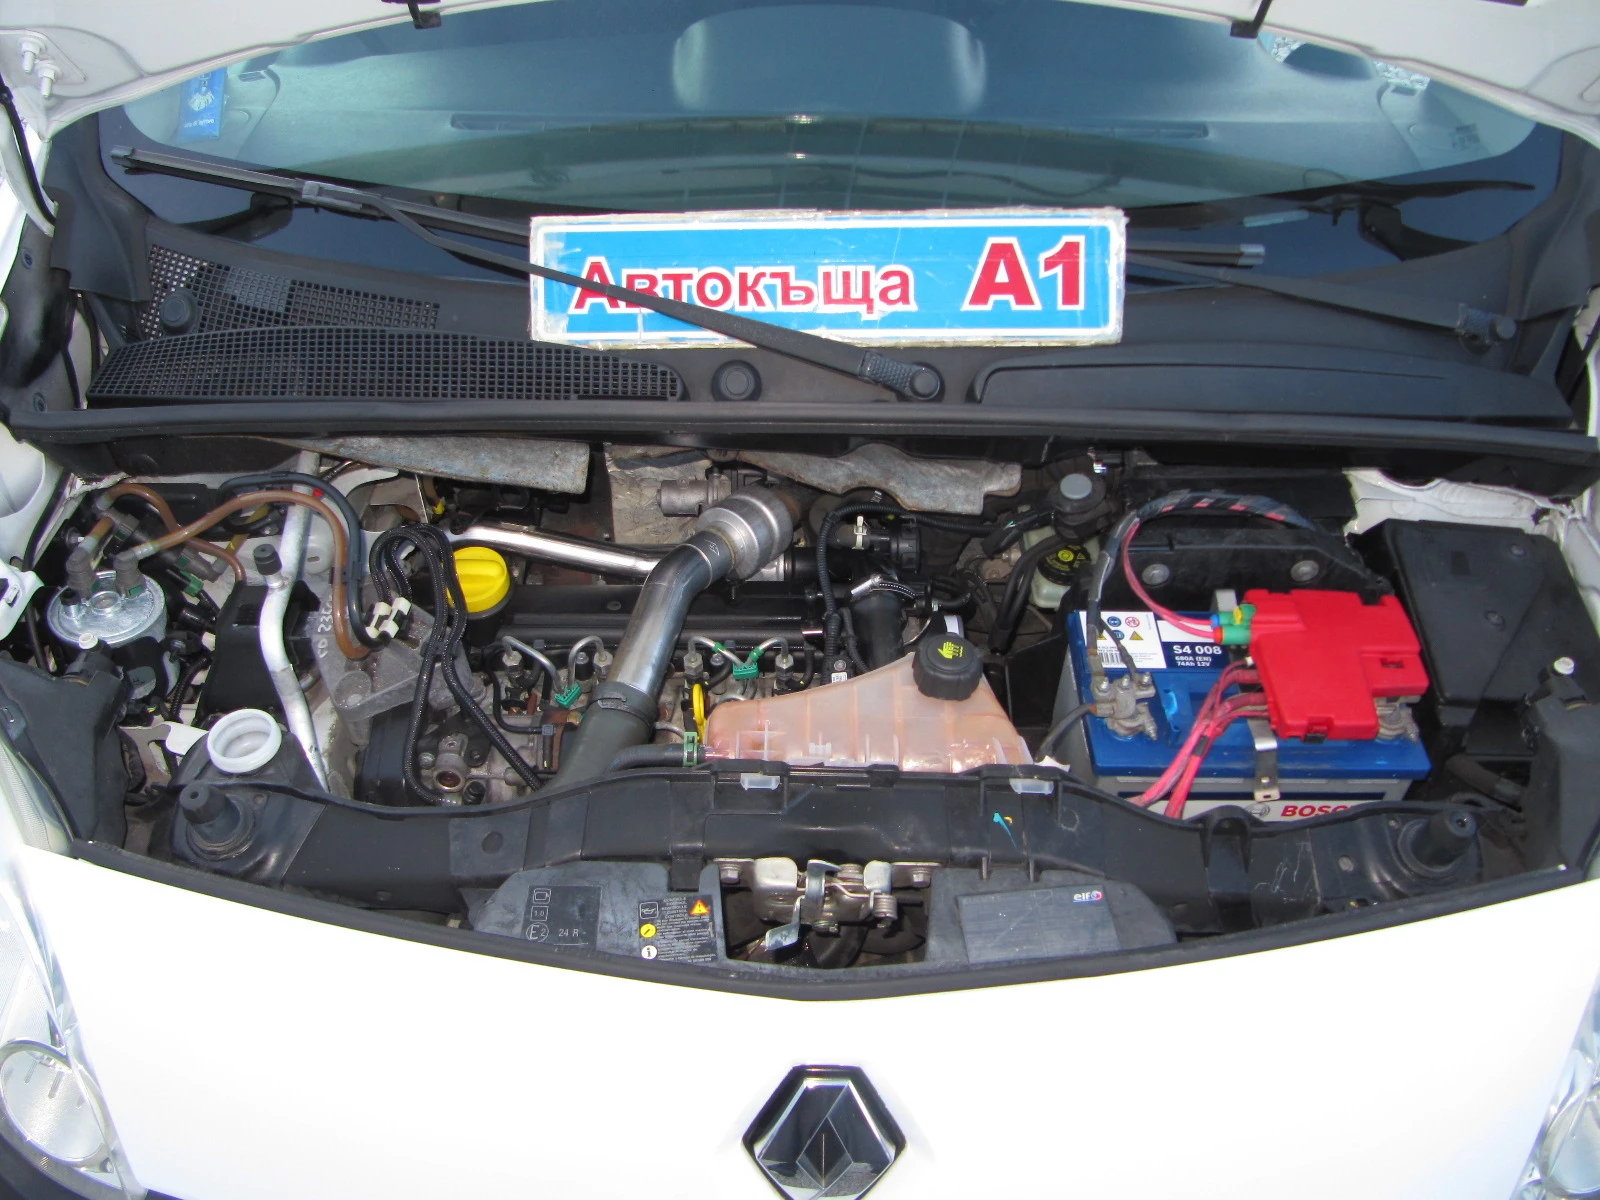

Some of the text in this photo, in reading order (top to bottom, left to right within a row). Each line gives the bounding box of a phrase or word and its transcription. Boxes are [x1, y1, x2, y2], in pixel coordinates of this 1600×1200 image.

[571, 259, 914, 317] Автокъща
[1172, 644, 1223, 655] S4 008
[558, 928, 569, 937] 24
[572, 928, 579, 937] R
